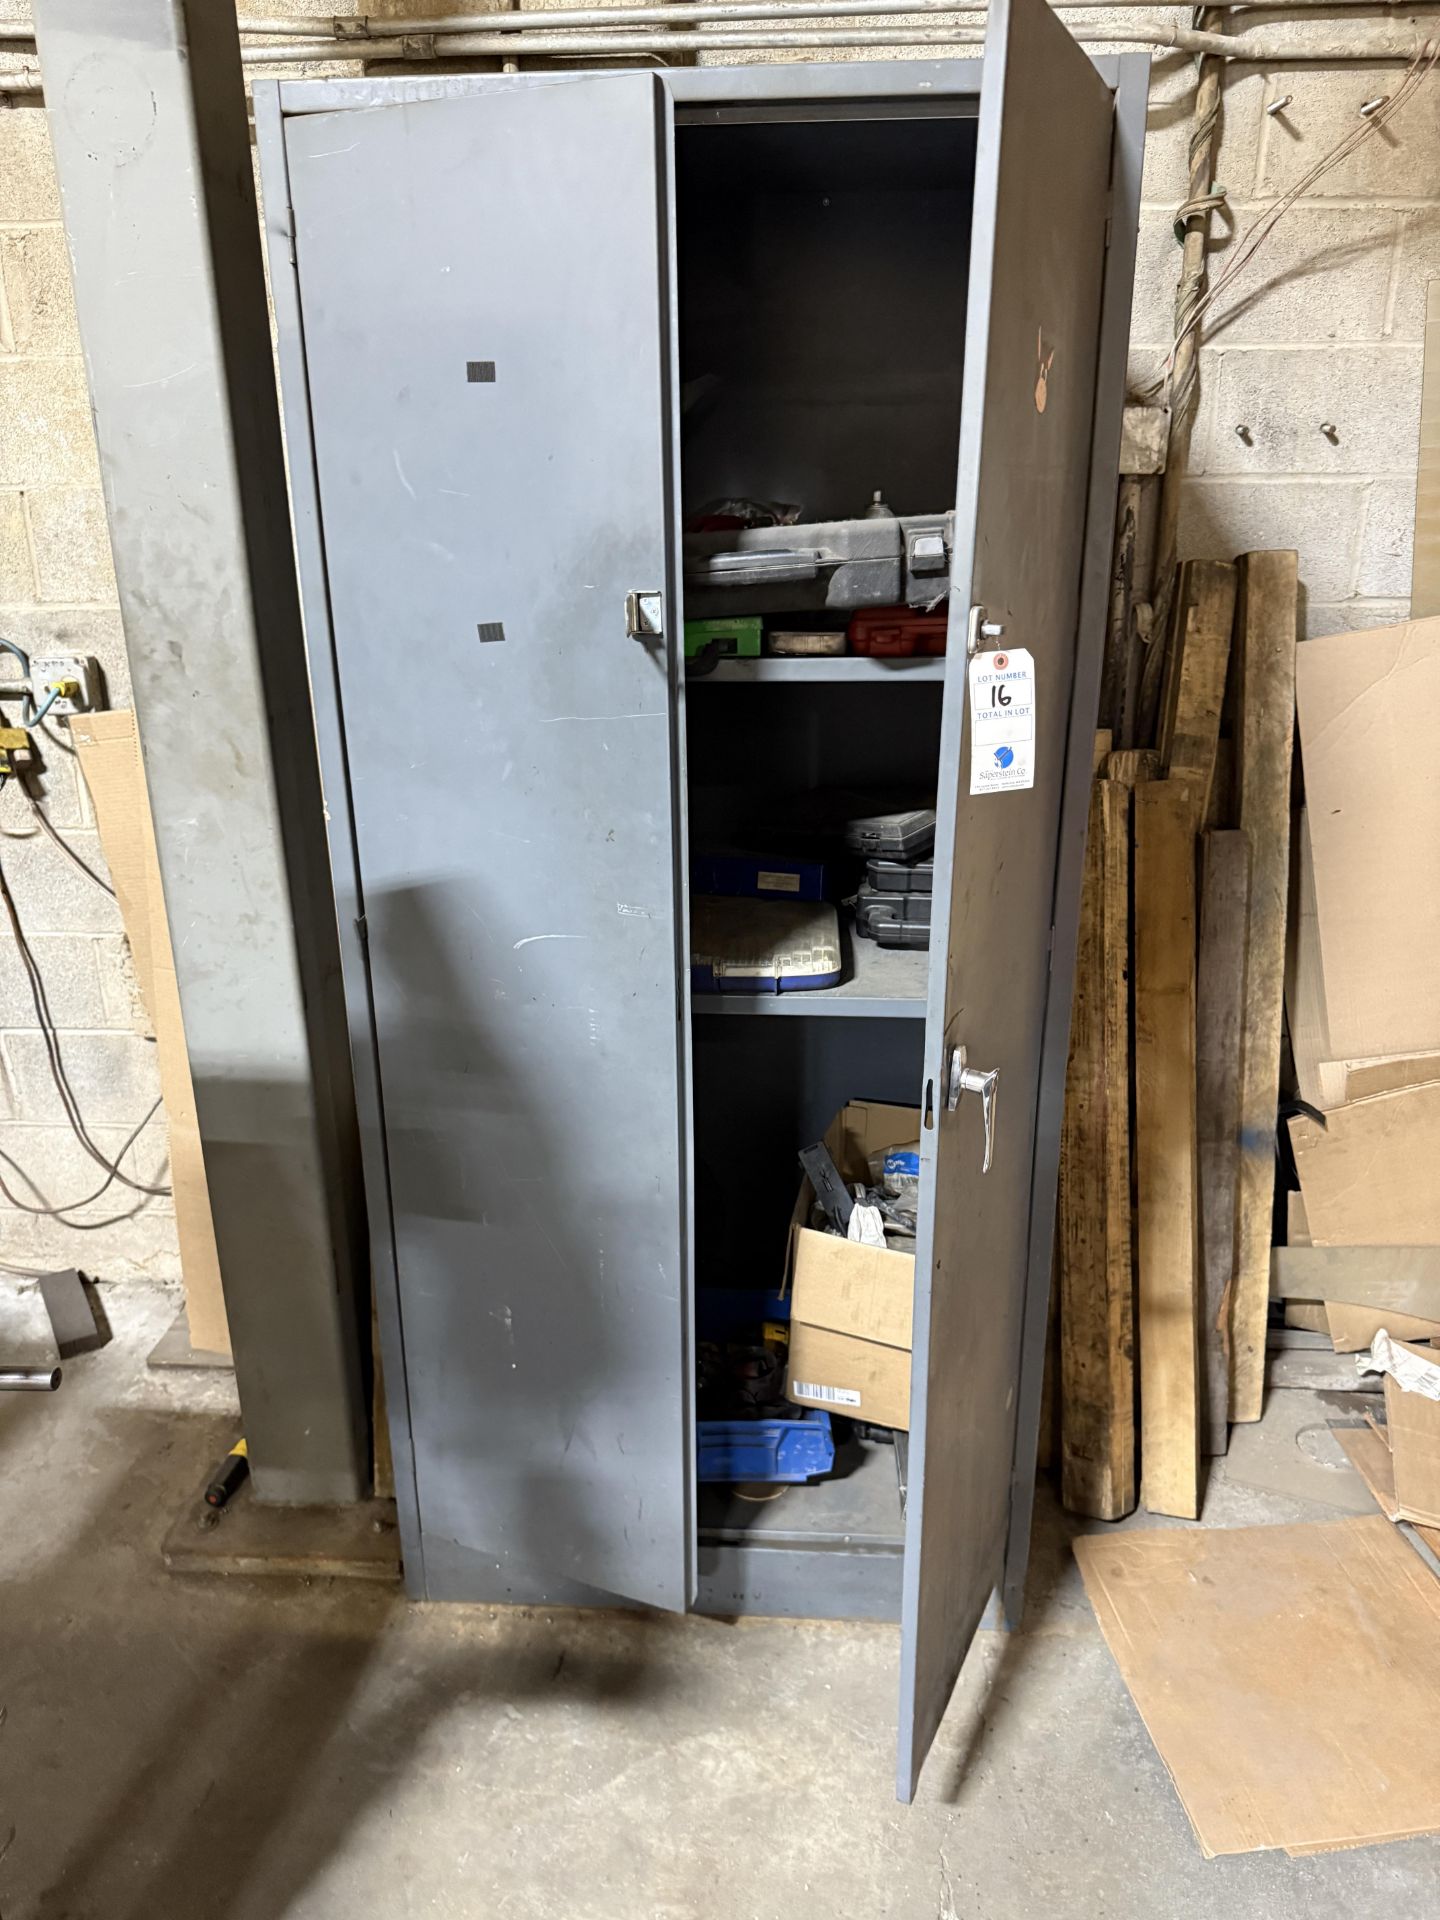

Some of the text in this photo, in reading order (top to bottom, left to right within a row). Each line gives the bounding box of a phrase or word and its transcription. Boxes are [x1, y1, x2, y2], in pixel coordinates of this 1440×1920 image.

[977, 671, 1027, 683] LOT NUMBER
[991, 684, 1012, 708] 16
[977, 707, 1030, 720] TOTAL IN LOT
